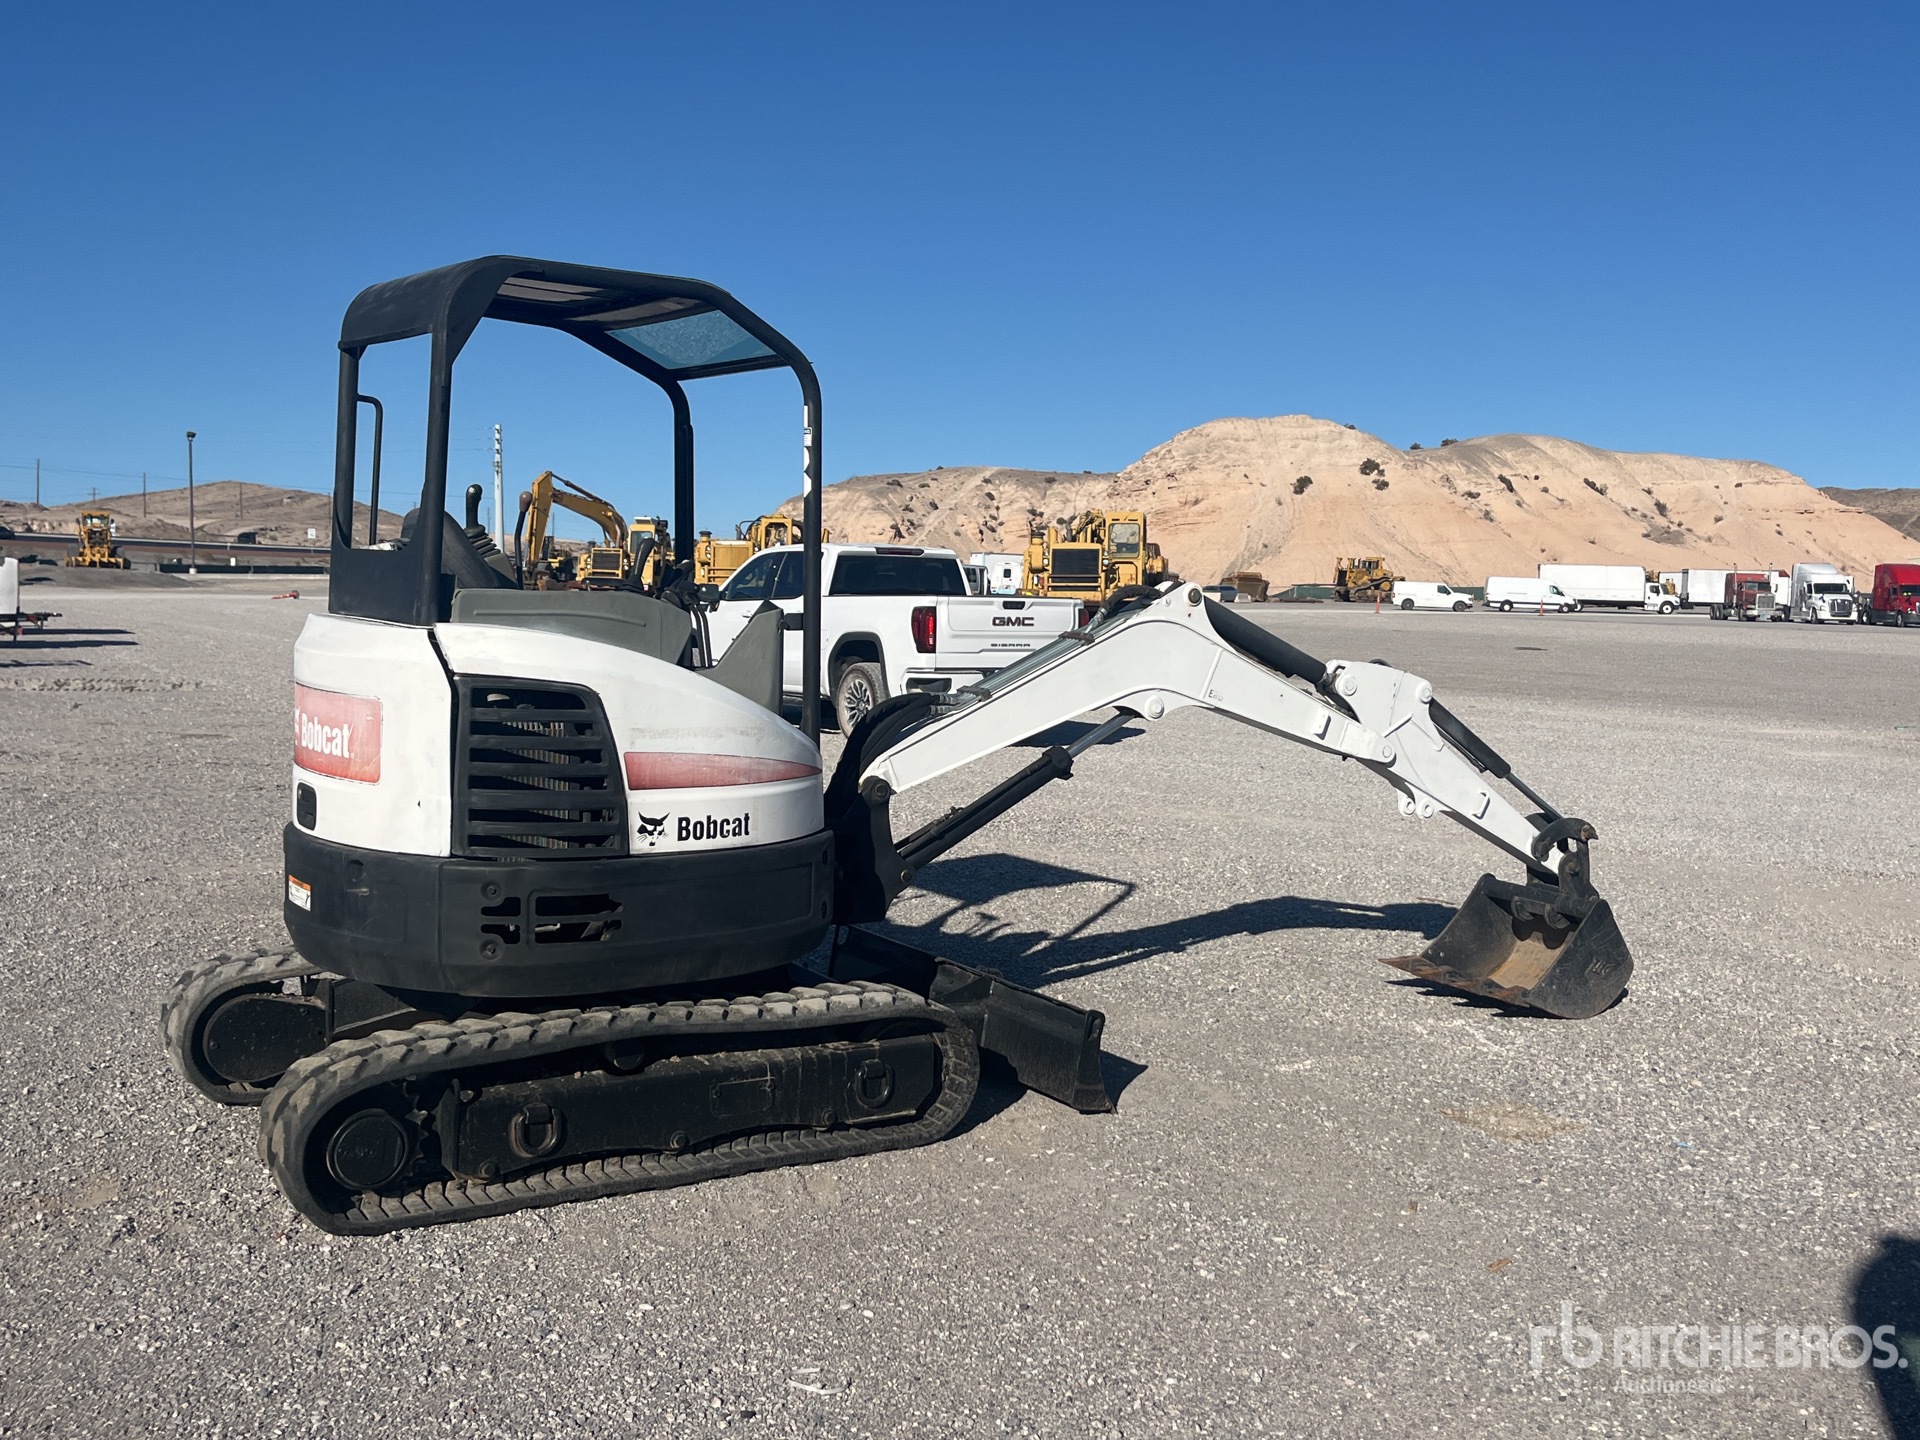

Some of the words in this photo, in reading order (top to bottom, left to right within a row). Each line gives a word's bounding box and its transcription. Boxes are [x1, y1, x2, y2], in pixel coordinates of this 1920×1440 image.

[992, 616, 1034, 627] GMC
[301, 712, 350, 759] Bobcat
[677, 812, 750, 841] Bobcat
